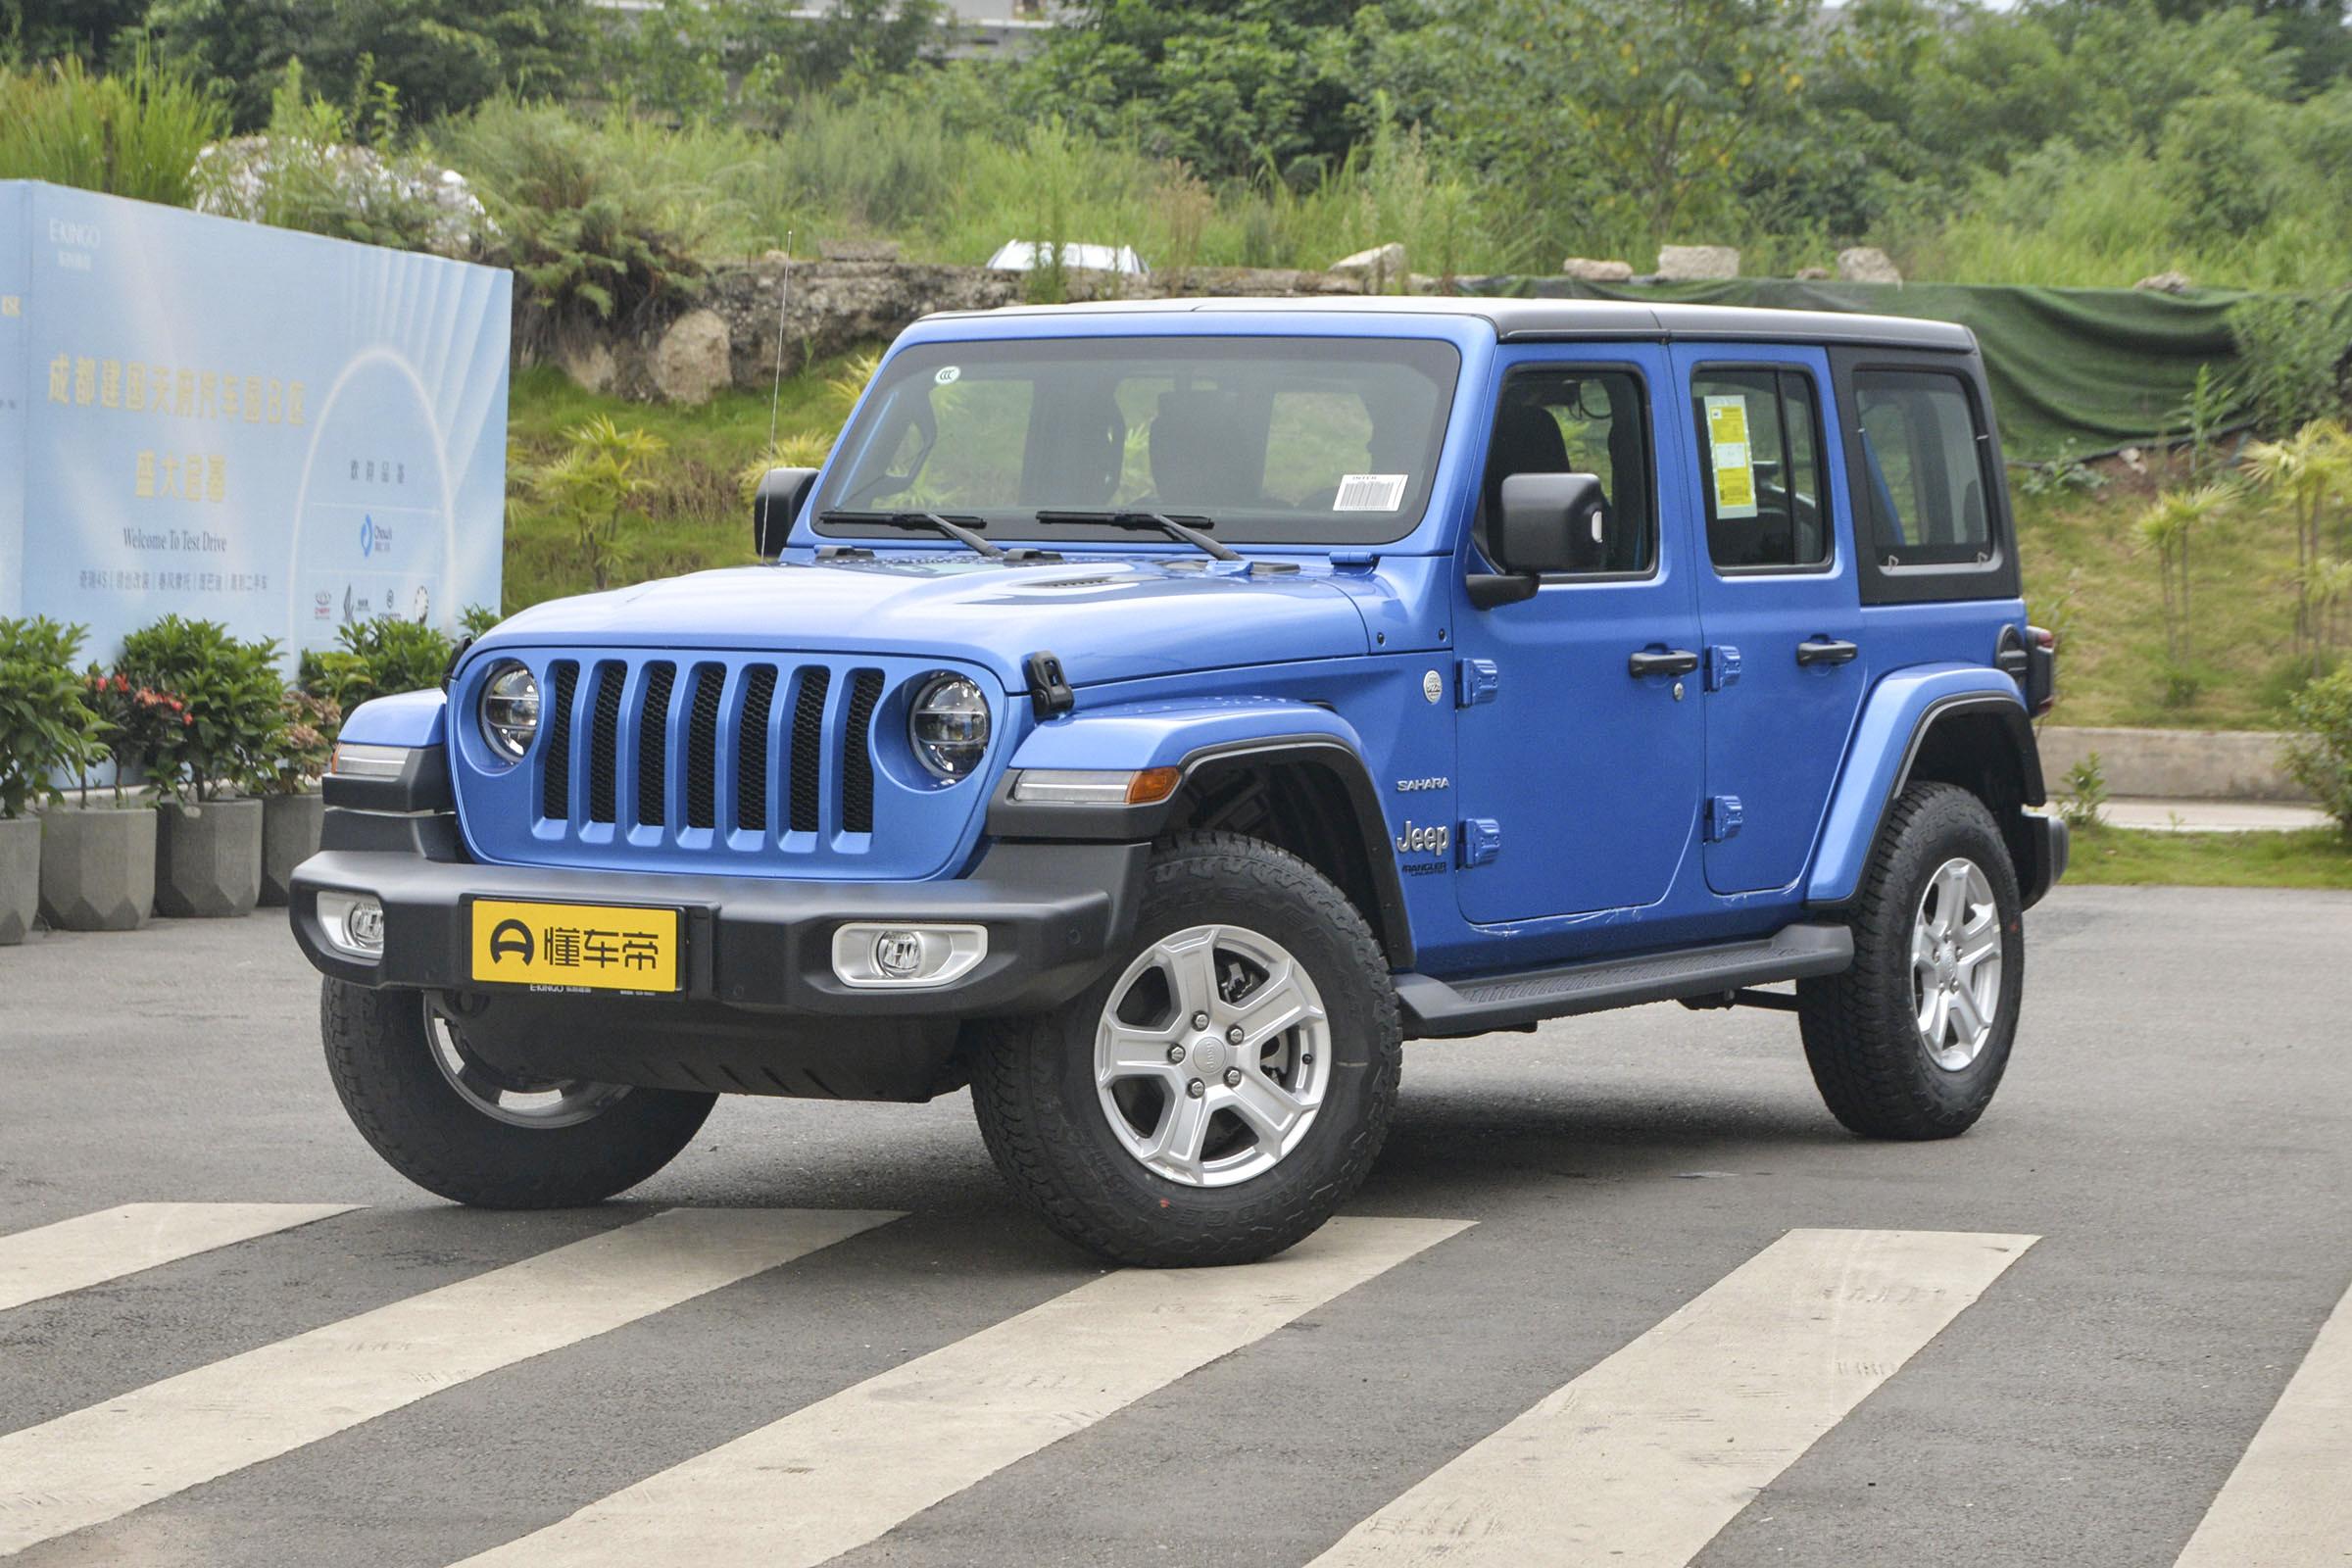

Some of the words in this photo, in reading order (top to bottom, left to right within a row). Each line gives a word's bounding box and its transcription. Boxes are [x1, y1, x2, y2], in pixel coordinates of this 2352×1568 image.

[122, 527, 166, 550] Welcome
[170, 529, 179, 550] To
[181, 530, 200, 551] Test
[203, 530, 227, 553] Drive
[1397, 777, 1449, 792] SAHARA
[1396, 820, 1449, 856] Jeep
[544, 926, 660, 971] 懂车帝
